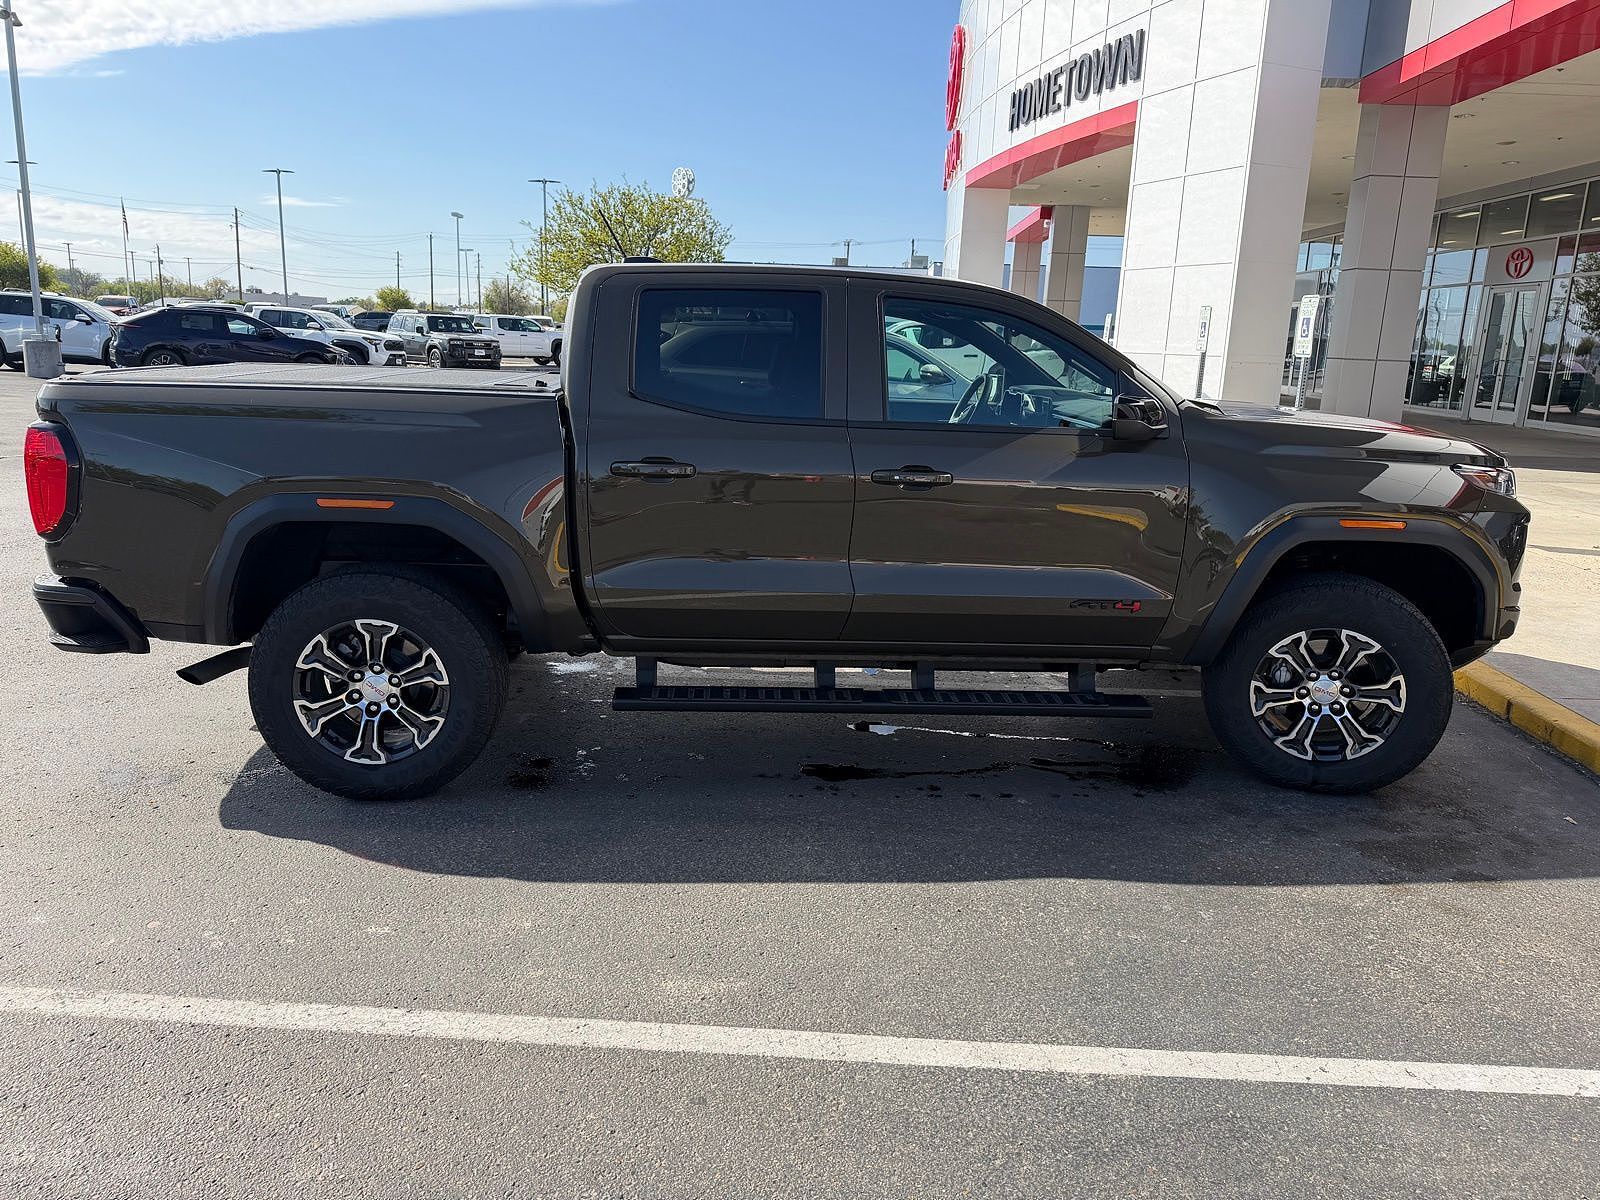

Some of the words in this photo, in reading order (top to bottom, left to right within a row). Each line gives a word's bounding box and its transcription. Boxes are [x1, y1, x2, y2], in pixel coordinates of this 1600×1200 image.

[1008, 28, 1145, 133] HOMETOWN
[1069, 599, 1141, 613] AT4
[365, 680, 386, 697] GMC
[1314, 686, 1336, 698] GMC
